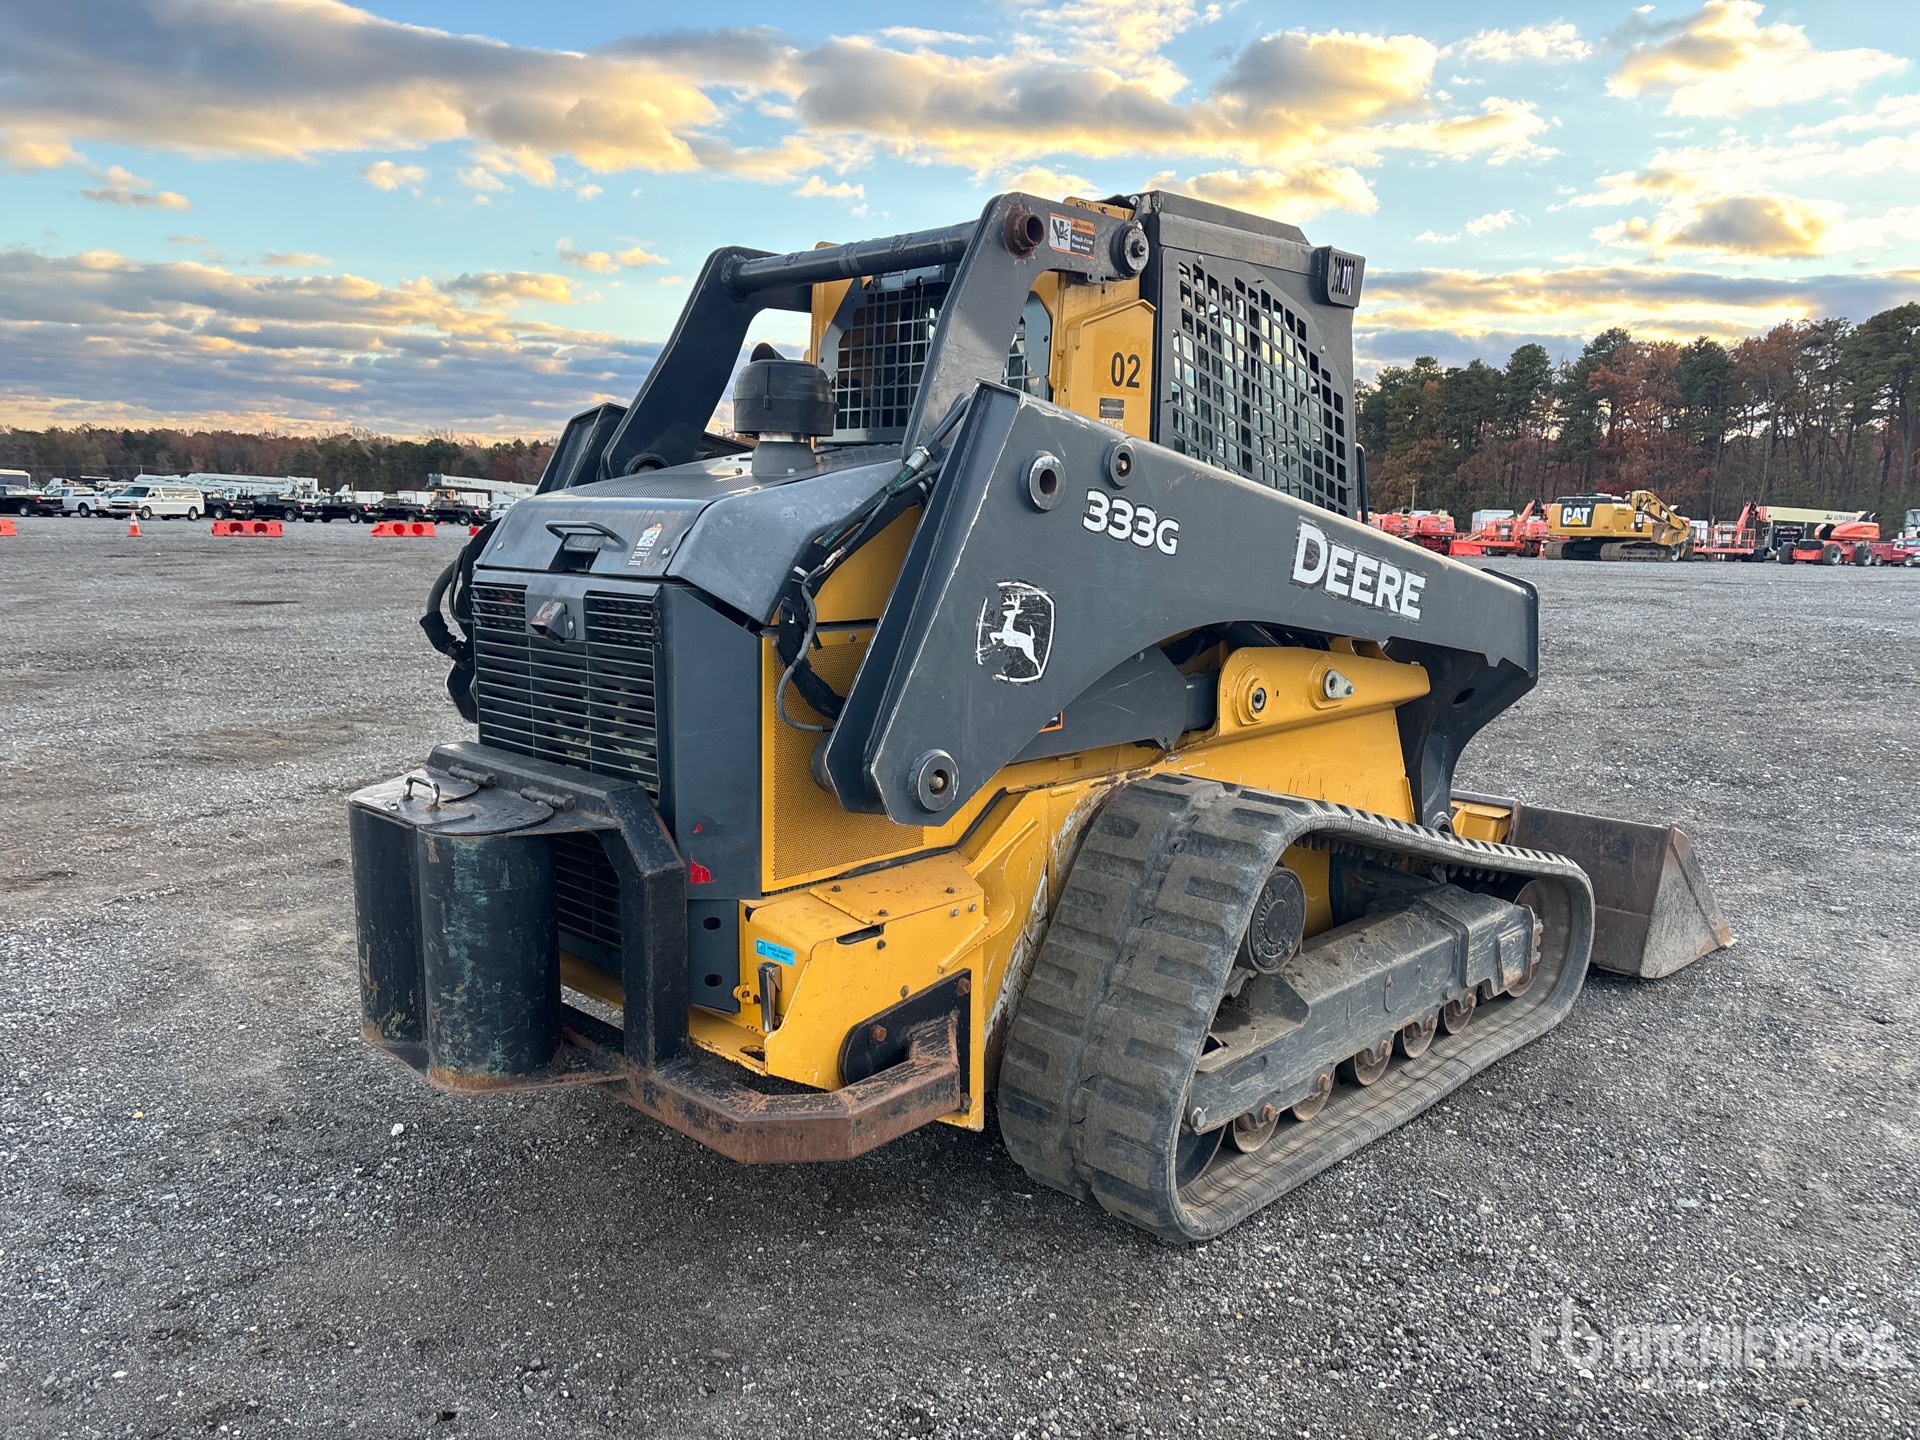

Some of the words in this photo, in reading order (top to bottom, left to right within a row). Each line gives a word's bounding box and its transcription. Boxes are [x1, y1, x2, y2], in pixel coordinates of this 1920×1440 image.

[1111, 352, 1141, 388] 02
[1082, 490, 1180, 555] 333G
[1562, 507, 1591, 525] CAT
[1292, 522, 1426, 620] DEERE
